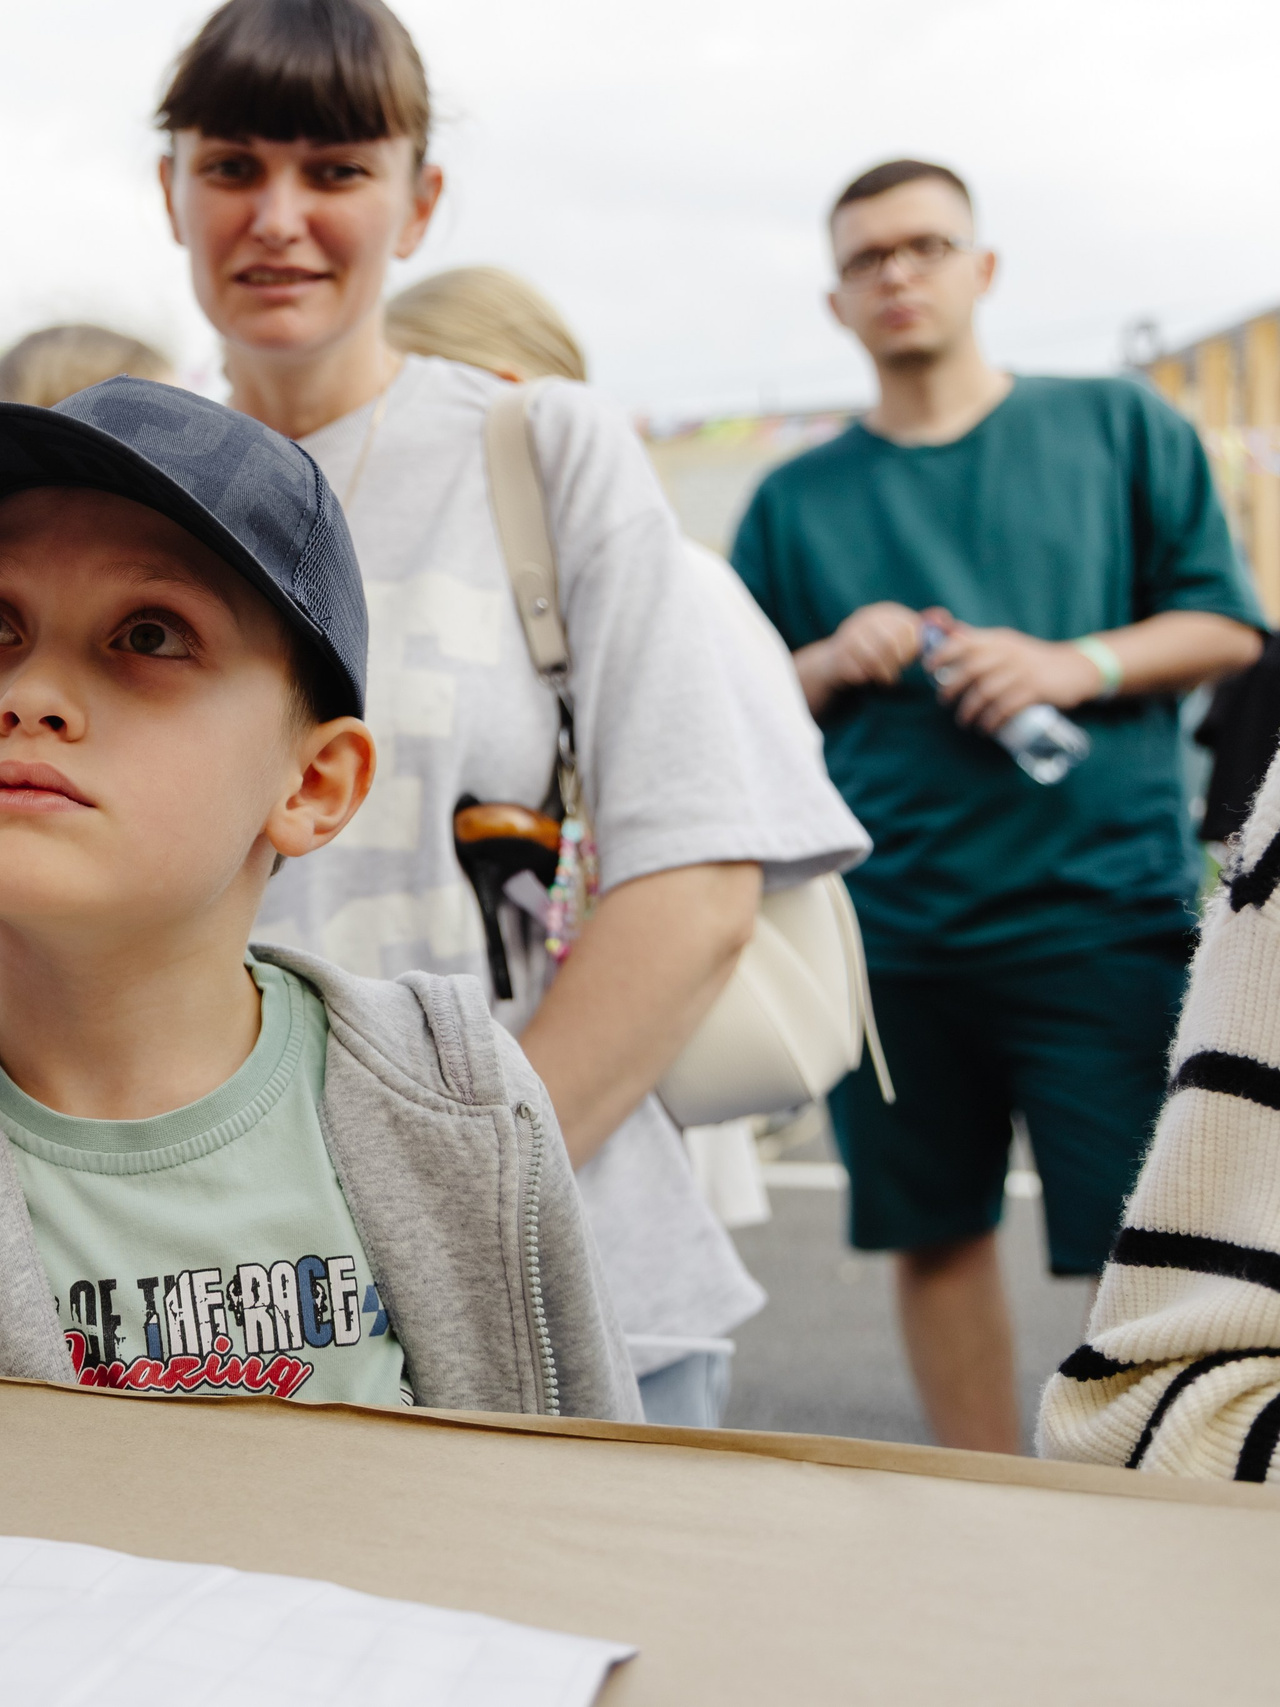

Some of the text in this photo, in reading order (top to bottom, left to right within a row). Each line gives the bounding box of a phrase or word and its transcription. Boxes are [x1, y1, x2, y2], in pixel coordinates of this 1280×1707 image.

[69, 1254, 361, 1366] OF THE RACE
